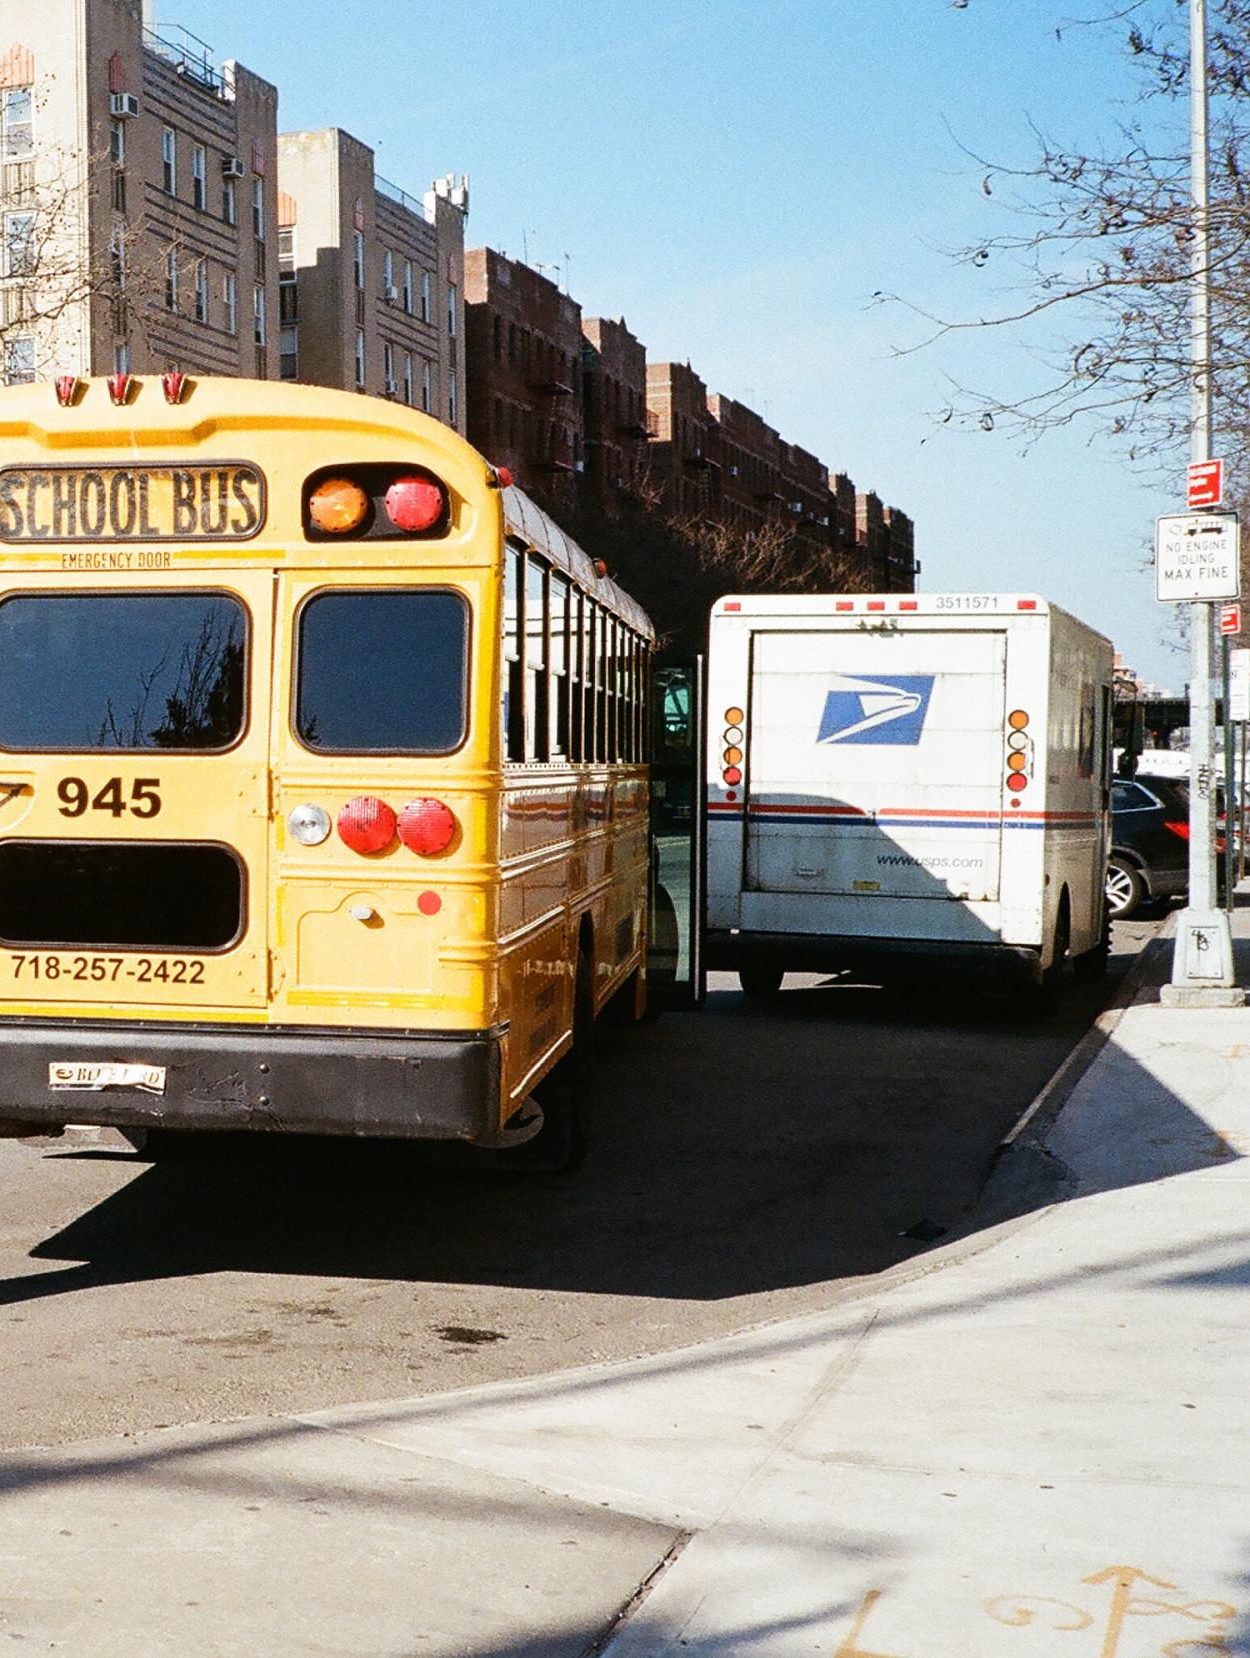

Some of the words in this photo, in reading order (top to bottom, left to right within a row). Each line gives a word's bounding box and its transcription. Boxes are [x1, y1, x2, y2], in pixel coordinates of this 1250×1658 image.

[0, 471, 161, 538] SCHOOL
[172, 469, 259, 535] BUS
[1165, 541, 1181, 553] NO
[1186, 539, 1228, 552] ENGINE
[61, 552, 132, 569] EMERGENCY
[138, 551, 171, 568] DOOR
[1178, 552, 1215, 565] IDLING
[1164, 568, 1192, 581] MAX
[1199, 565, 1229, 579] FINE
[935, 596, 999, 609] 3511571
[57, 776, 162, 819] 945
[876, 855, 983, 869] www.usps.com
[10, 955, 205, 985] 718-257-2422
